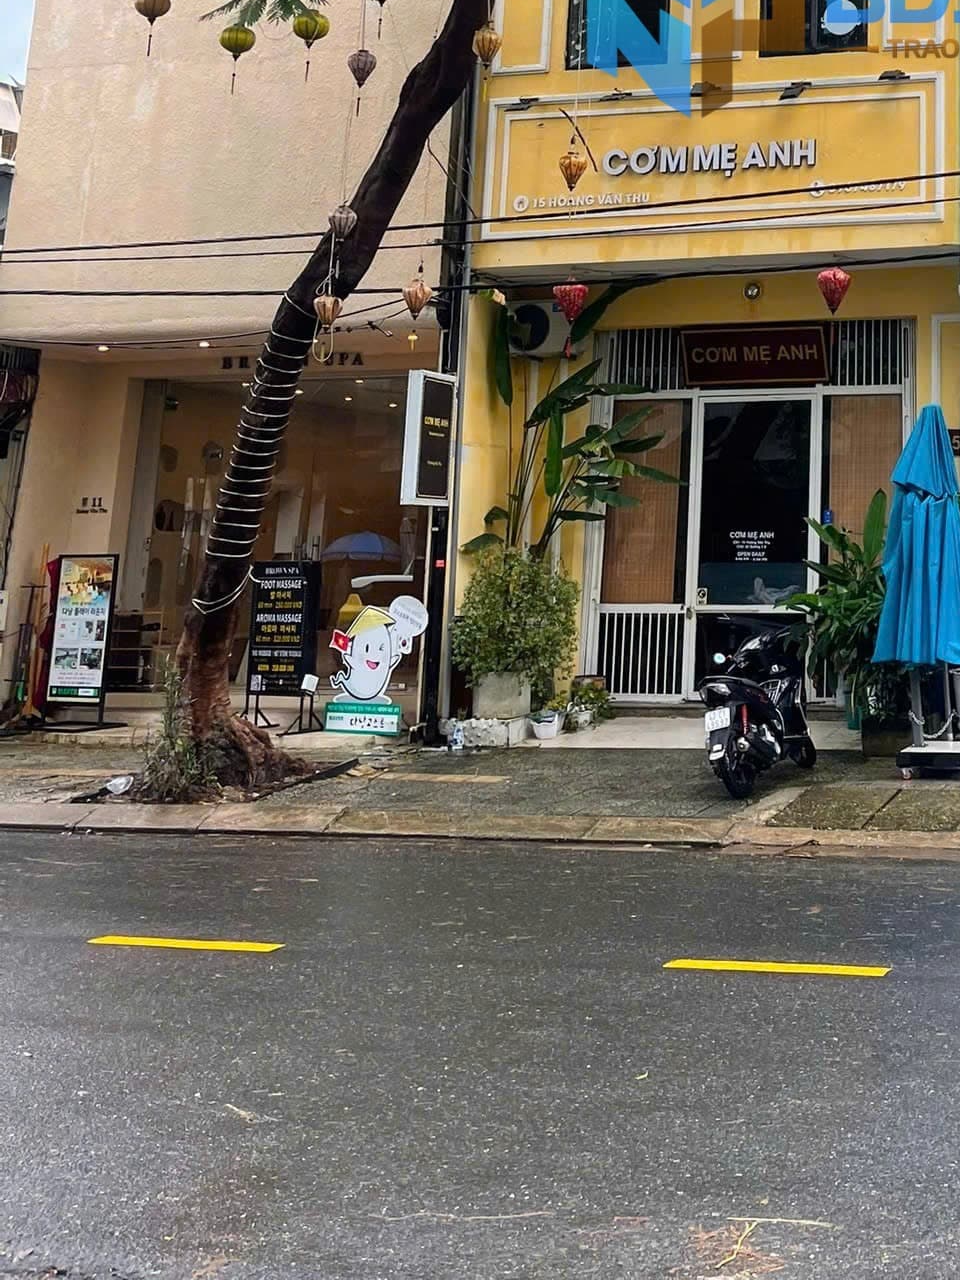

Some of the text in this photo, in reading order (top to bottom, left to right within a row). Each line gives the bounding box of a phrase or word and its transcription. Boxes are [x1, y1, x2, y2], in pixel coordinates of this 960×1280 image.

[602, 139, 816, 177] CƠM MẸ ANH
[533, 198, 546, 208] 15
[691, 344, 818, 365] CƠM MẸ ANH
[260, 580, 302, 589] FOOT MASSAGE
[276, 613, 302, 623] MASSAGE
